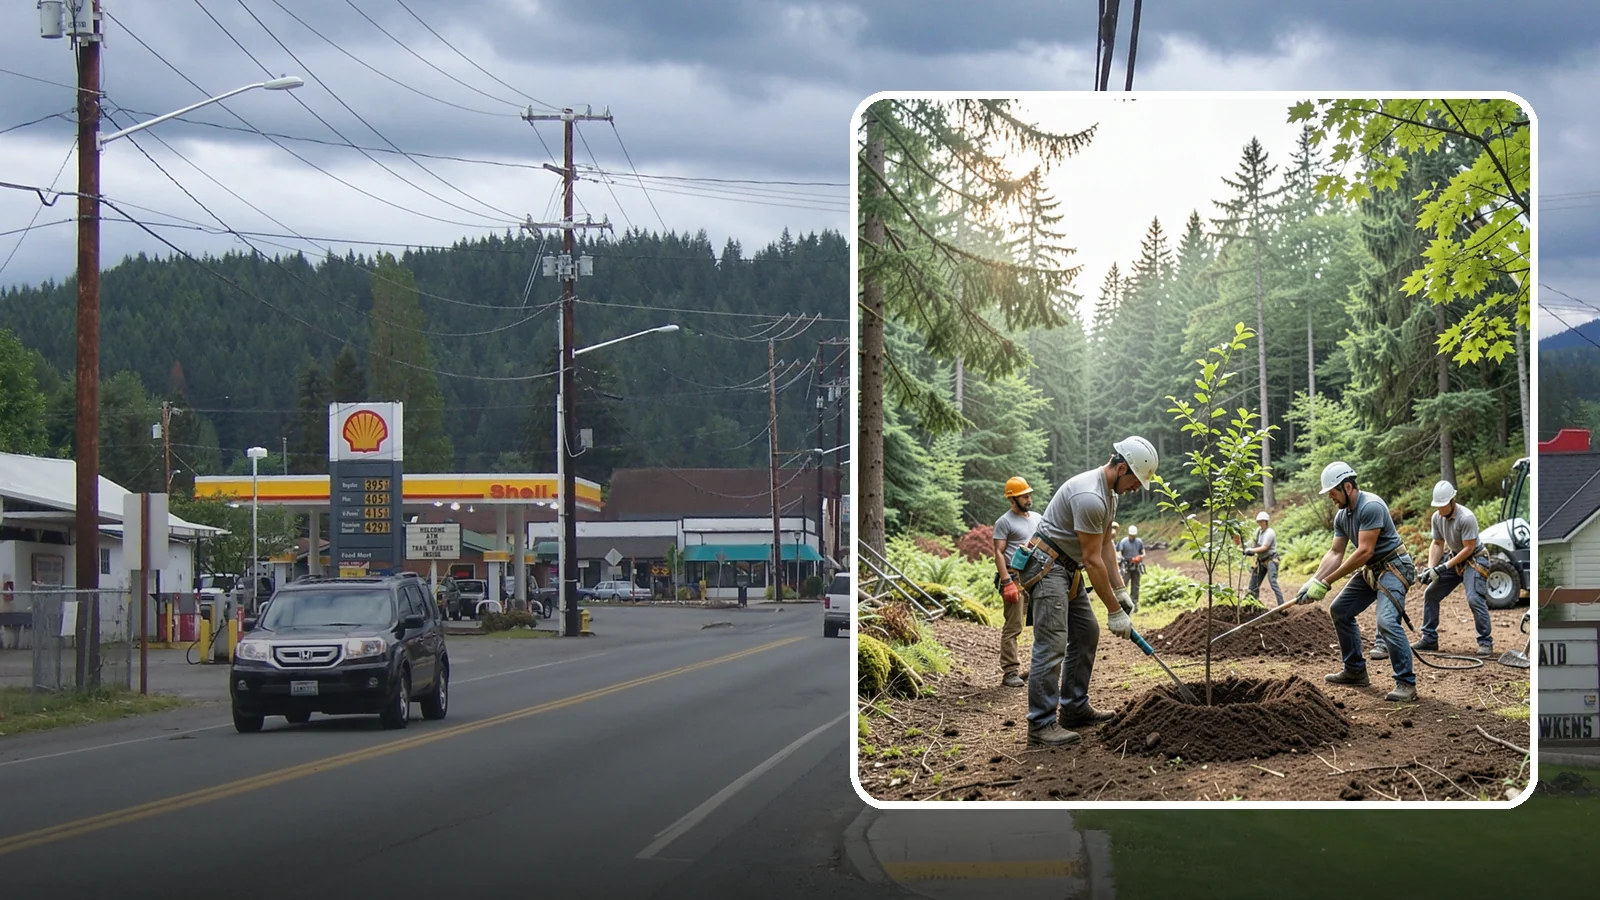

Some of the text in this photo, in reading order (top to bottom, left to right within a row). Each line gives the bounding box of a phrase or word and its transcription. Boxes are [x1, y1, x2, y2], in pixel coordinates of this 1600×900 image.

[366, 480, 383, 490] 395
[490, 484, 547, 498] Shell
[365, 494, 383, 504] 405
[365, 508, 383, 518] 415
[366, 522, 383, 532] 429
